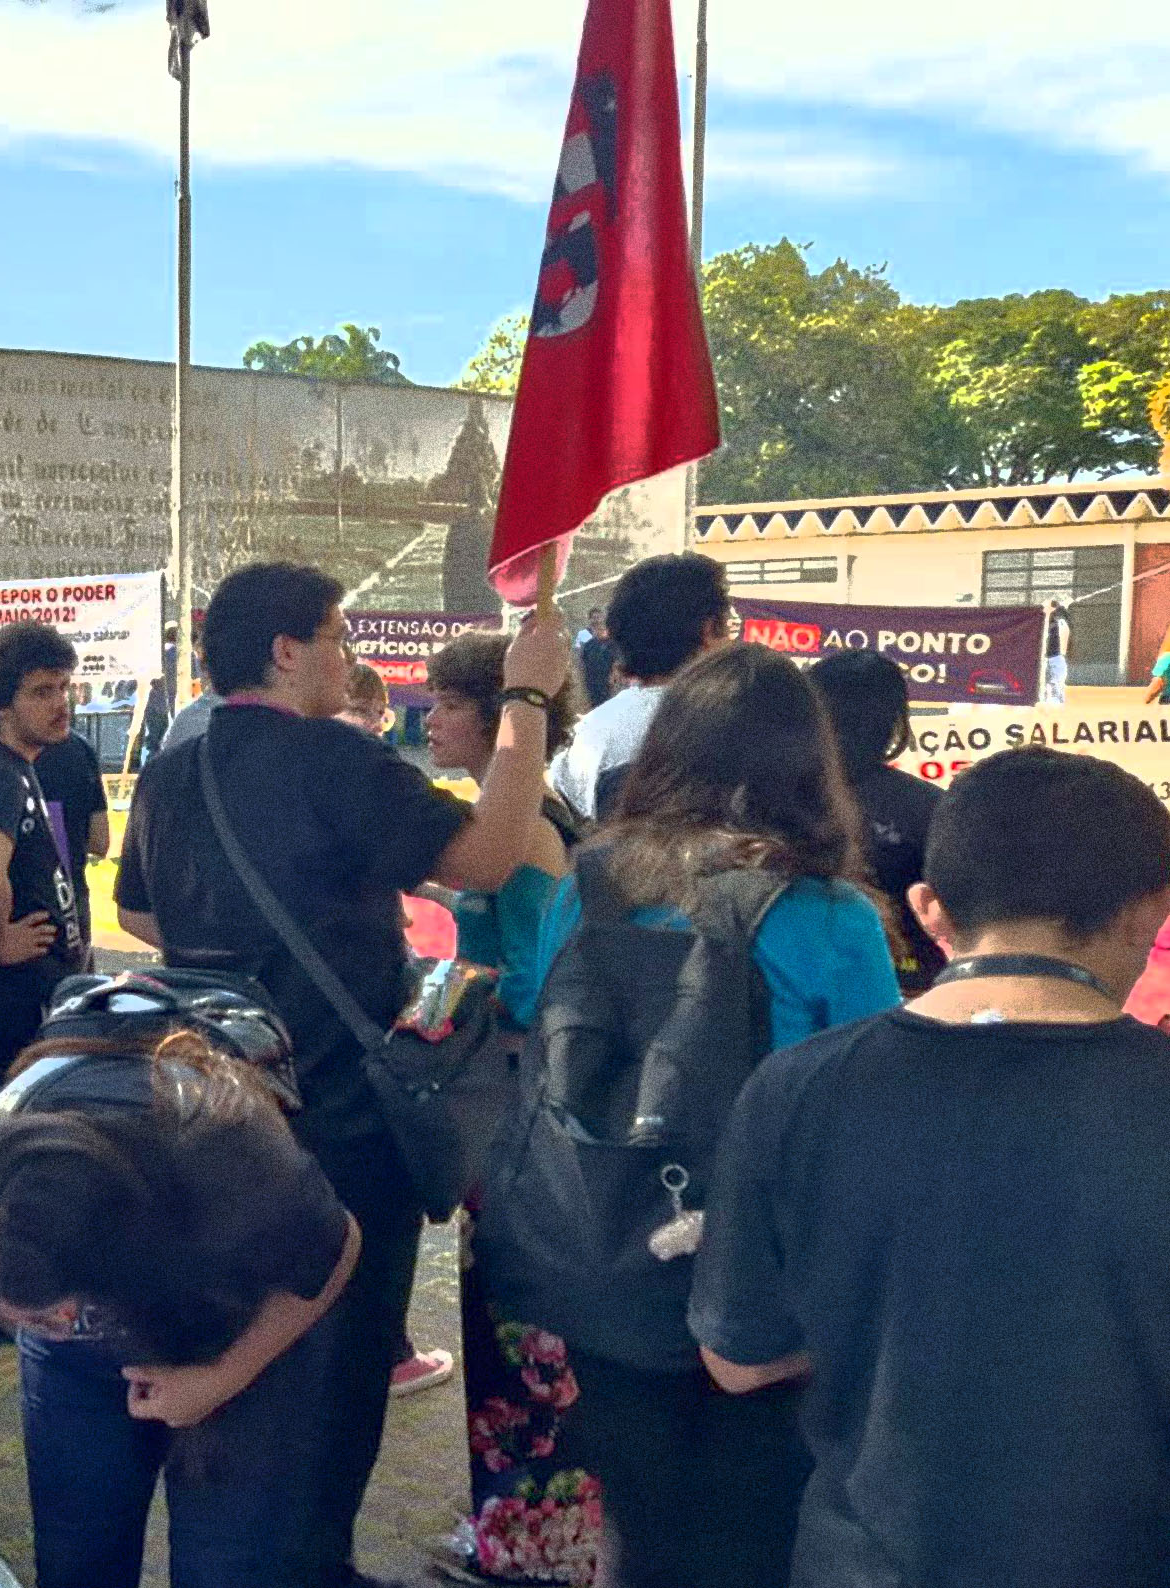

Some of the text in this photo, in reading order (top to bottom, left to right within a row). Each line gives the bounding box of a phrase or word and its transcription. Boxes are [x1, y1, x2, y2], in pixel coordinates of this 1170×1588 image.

[45, 587, 59, 603] O
[62, 584, 117, 602] PODER
[748, 618, 816, 652] NÃO
[823, 628, 869, 650] AO
[877, 629, 992, 656] PONTO
